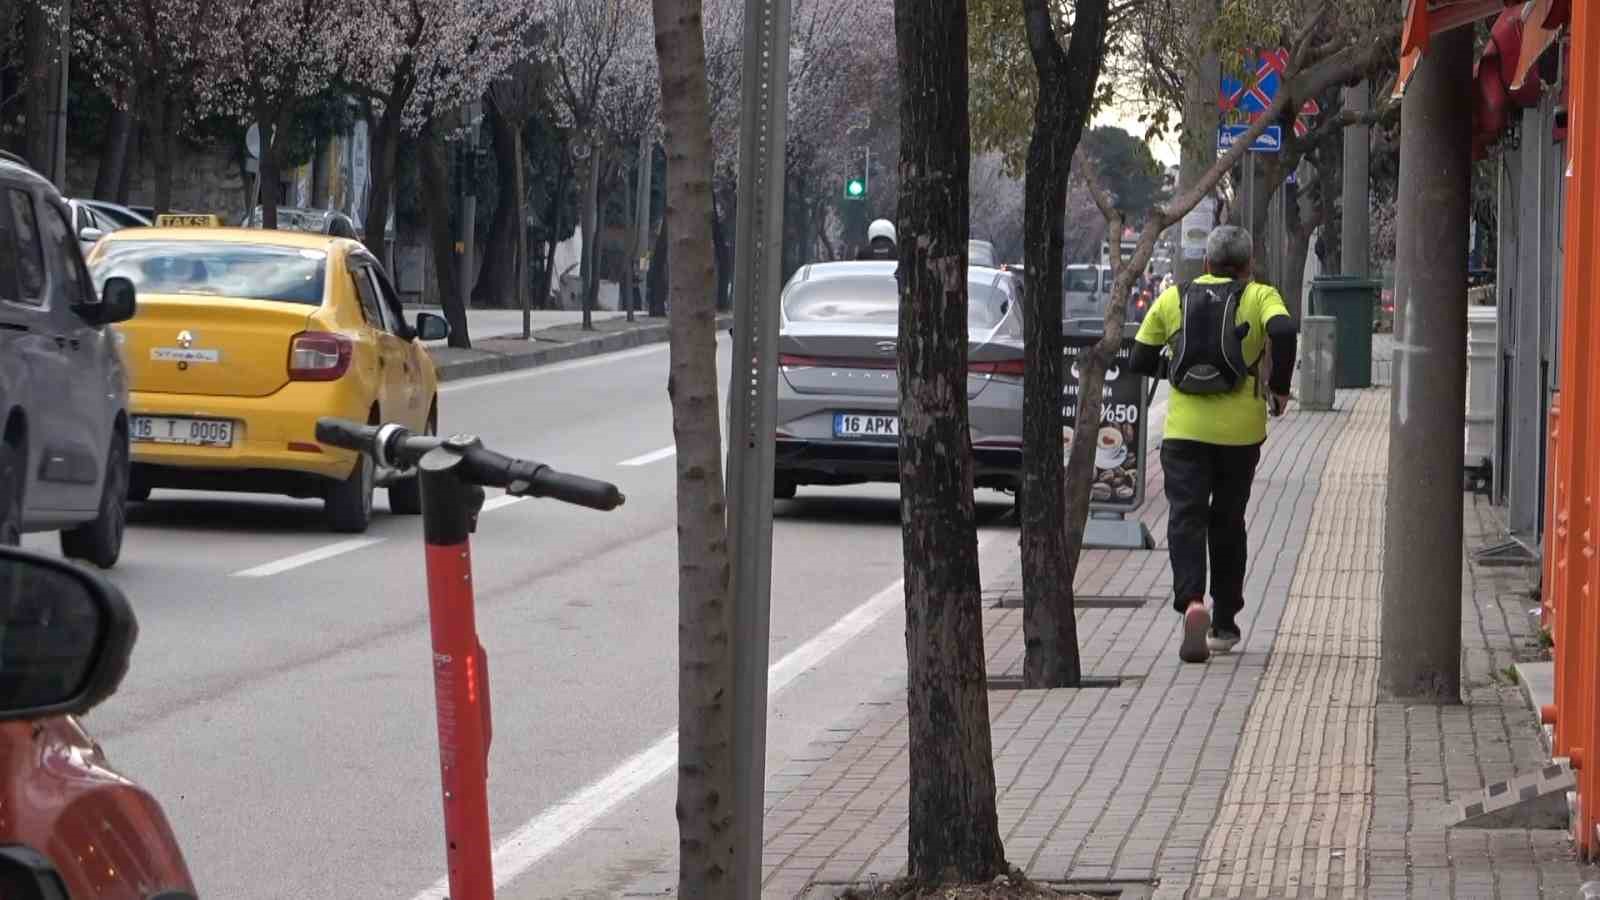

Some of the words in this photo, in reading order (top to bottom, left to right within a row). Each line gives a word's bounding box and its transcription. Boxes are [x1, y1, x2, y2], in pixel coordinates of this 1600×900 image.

[1099, 403, 1138, 423] %50
[137, 419, 152, 436] 16
[167, 421, 177, 437] T
[190, 421, 228, 440] 0006
[843, 416, 861, 432] 16
[865, 417, 894, 433] APK
